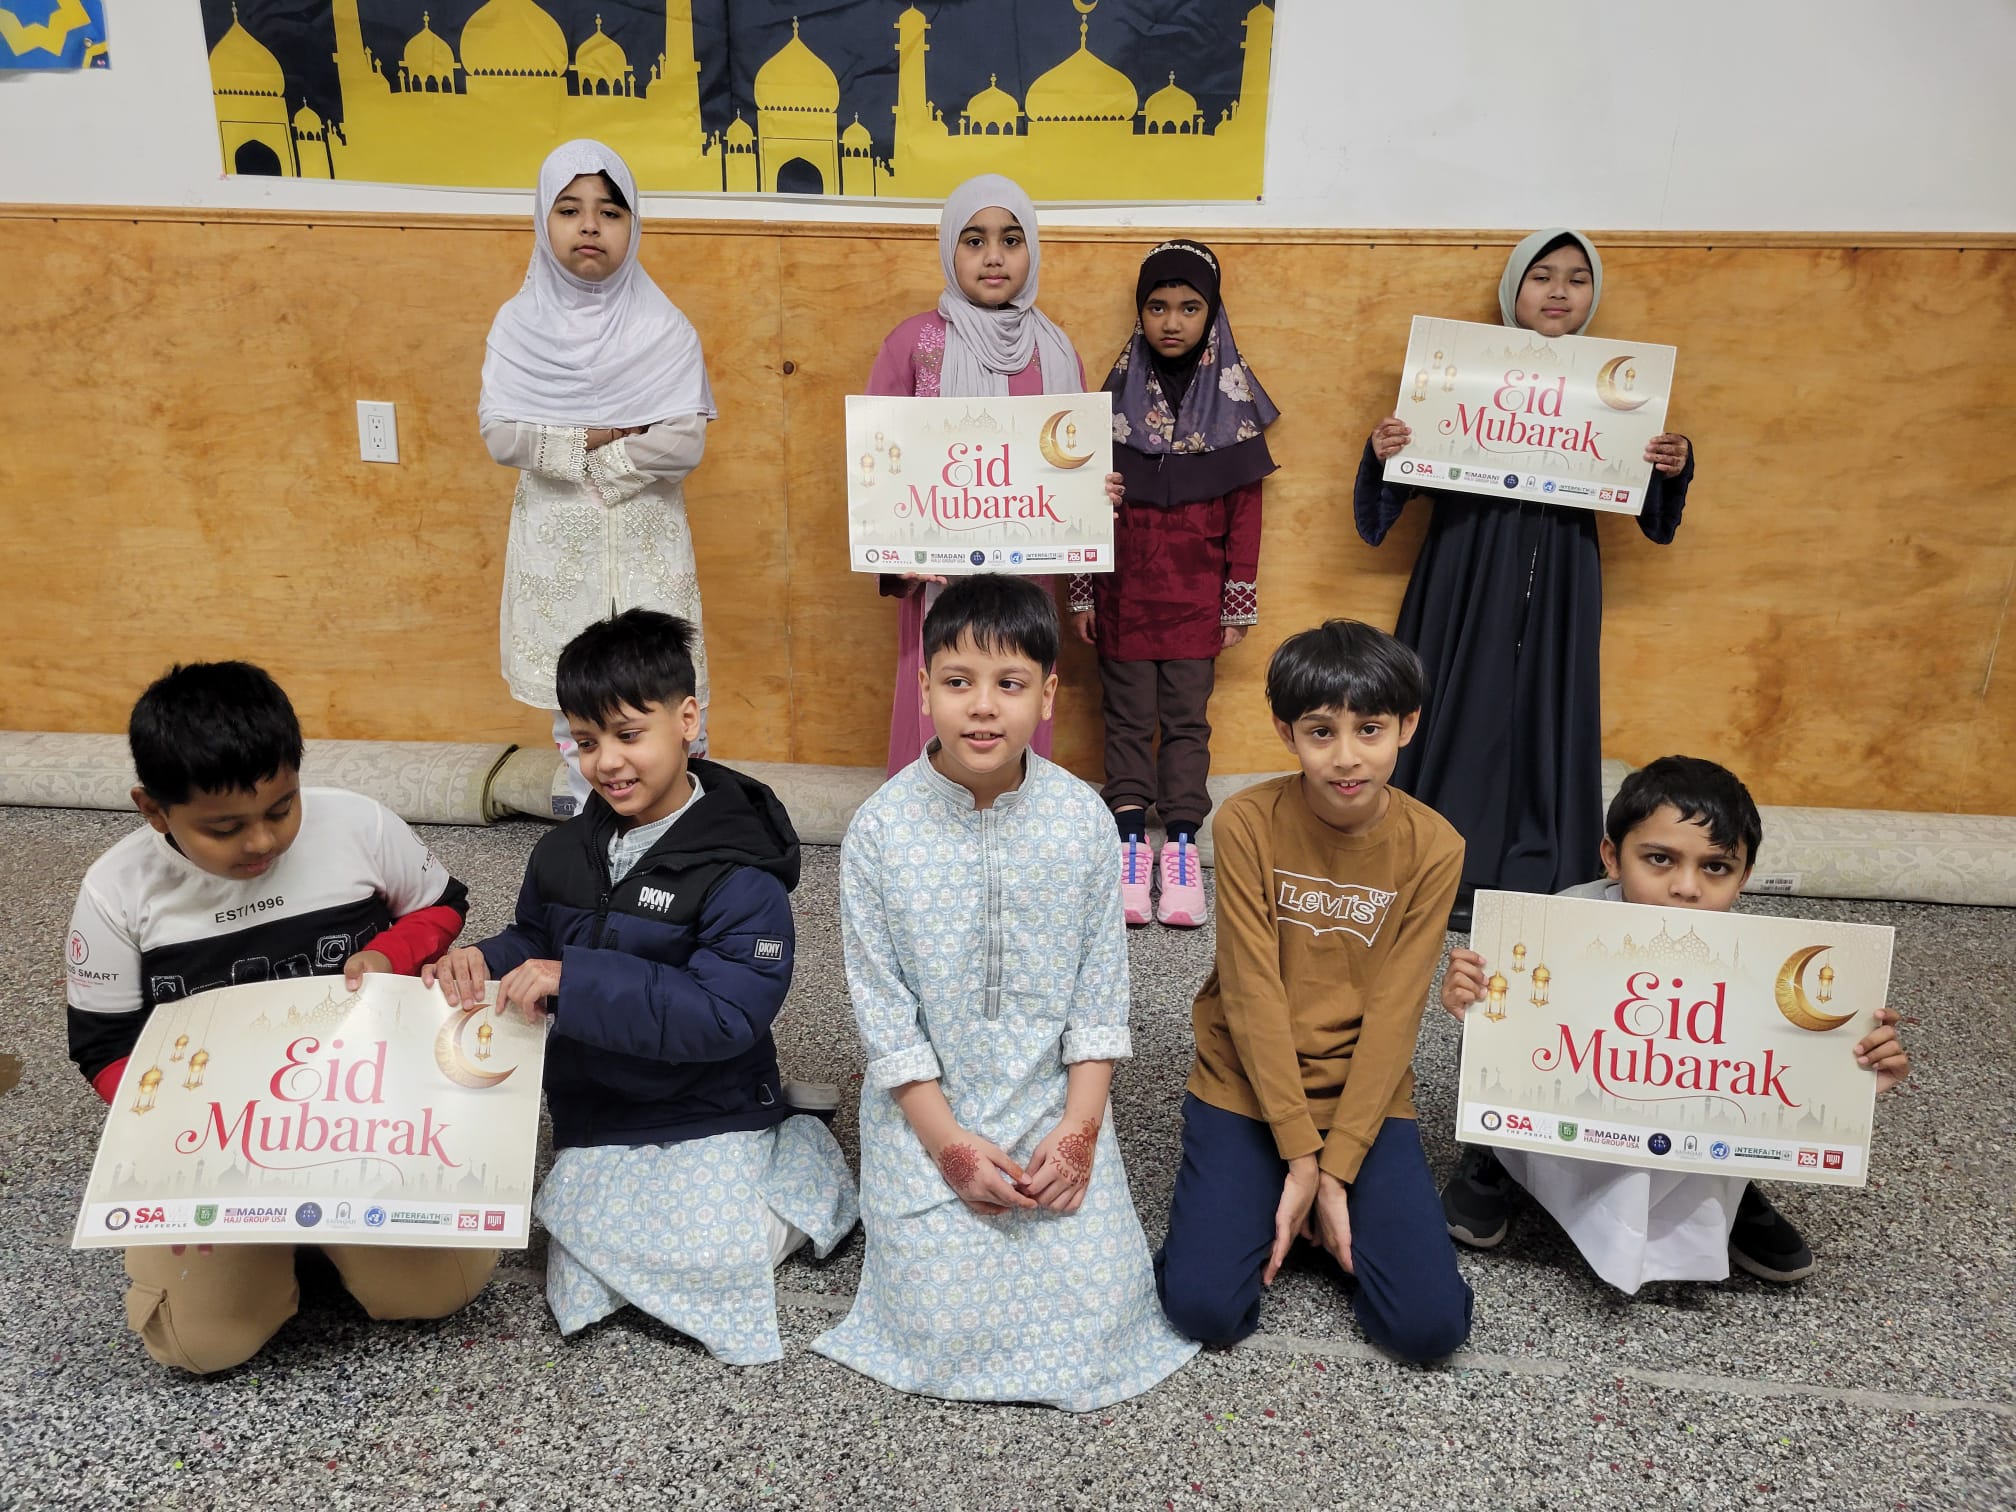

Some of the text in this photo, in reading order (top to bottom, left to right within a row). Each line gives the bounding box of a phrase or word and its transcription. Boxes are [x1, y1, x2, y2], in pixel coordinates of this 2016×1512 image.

[1493, 369, 1566, 417] Eid
[1438, 403, 1606, 469] Mubarak
[942, 443, 1013, 487] Eid
[894, 484, 1067, 536] Mubarak
[638, 886, 675, 908] DKNY
[215, 896, 285, 923] EST/1996
[759, 942, 780, 954] DKNY
[78, 968, 119, 981] SMART
[1614, 971, 1726, 1044] Eid
[269, 1036, 388, 1104] Eid
[1532, 1024, 1802, 1122] Mubarak
[175, 1100, 463, 1184] Mubarak
[1583, 1136, 1600, 1145] HAJJ
[1601, 1138, 1625, 1147] GROUP
[1595, 1129, 1640, 1143] MADANI
[1799, 1152, 1817, 1165] 786
[236, 1208, 287, 1216] MADANI
[271, 1215, 286, 1223] USA
[460, 1215, 477, 1228] 786
